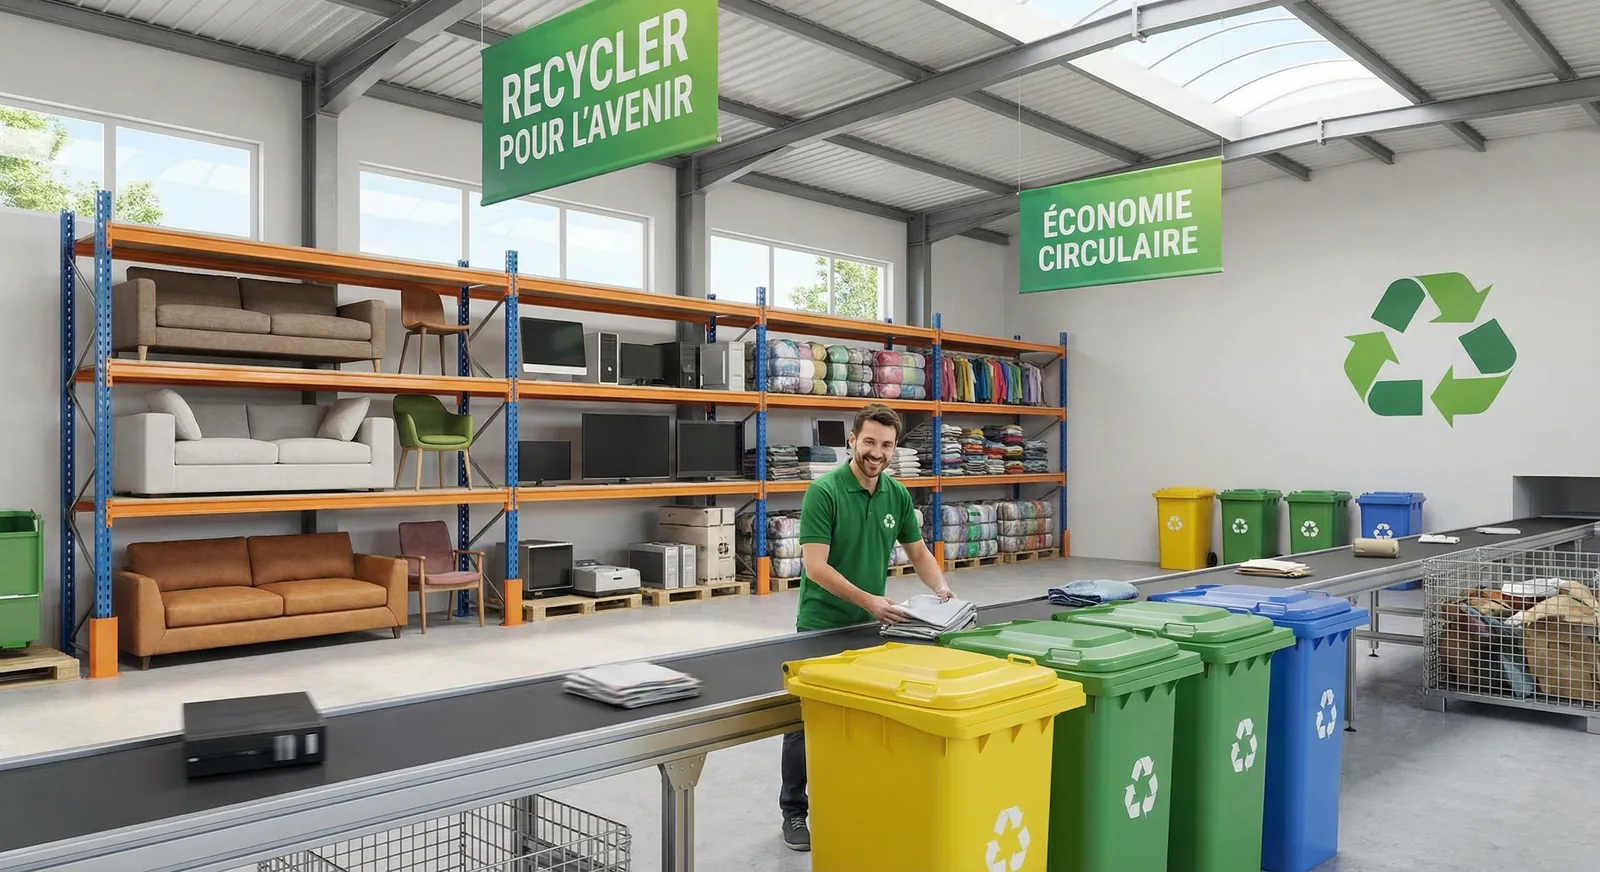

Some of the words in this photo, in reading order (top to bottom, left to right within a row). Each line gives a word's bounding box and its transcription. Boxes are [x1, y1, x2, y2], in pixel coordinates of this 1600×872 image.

[502, 8, 688, 124] RECYCLER
[500, 117, 564, 170] POUR
[572, 74, 693, 148] L'AVENIR
[1038, 225, 1198, 272] CIRCULAIRE
[1043, 189, 1193, 239] ÉCONOMIE
